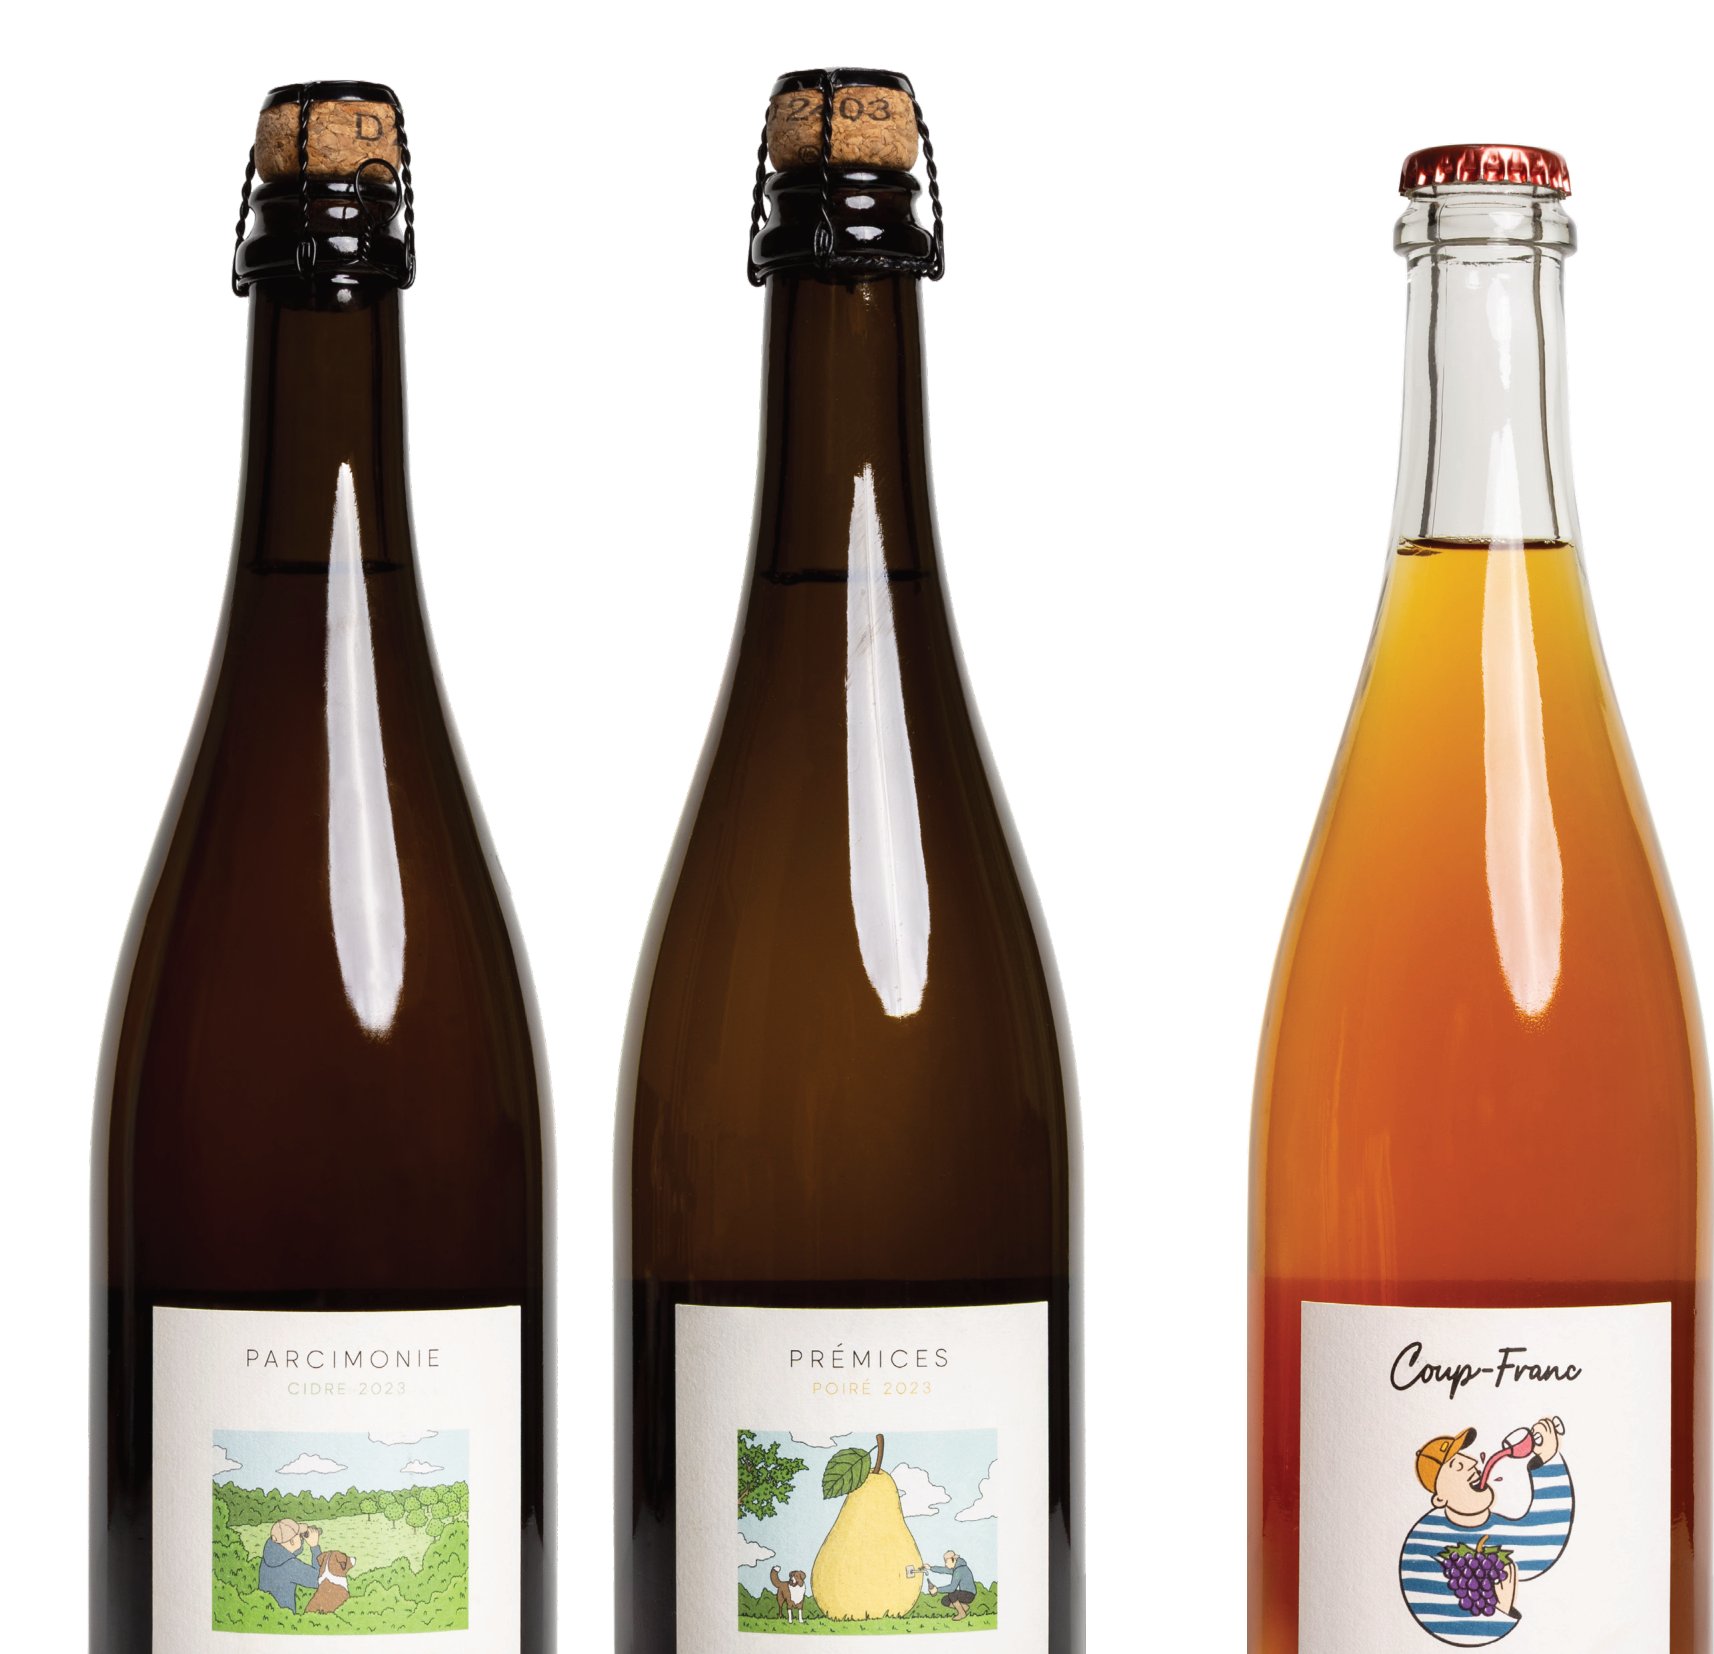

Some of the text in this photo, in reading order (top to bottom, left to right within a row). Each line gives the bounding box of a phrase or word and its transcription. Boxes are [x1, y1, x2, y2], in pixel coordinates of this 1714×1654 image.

[246, 1349, 440, 1369] PARCIMONIE
[790, 1343, 948, 1369] PRÉMICES
[1390, 1341, 1582, 1400] Coup-Franc
[287, 1381, 406, 1396] CIDRE 2023
[812, 1378, 932, 1396] POIRÉ 2023
